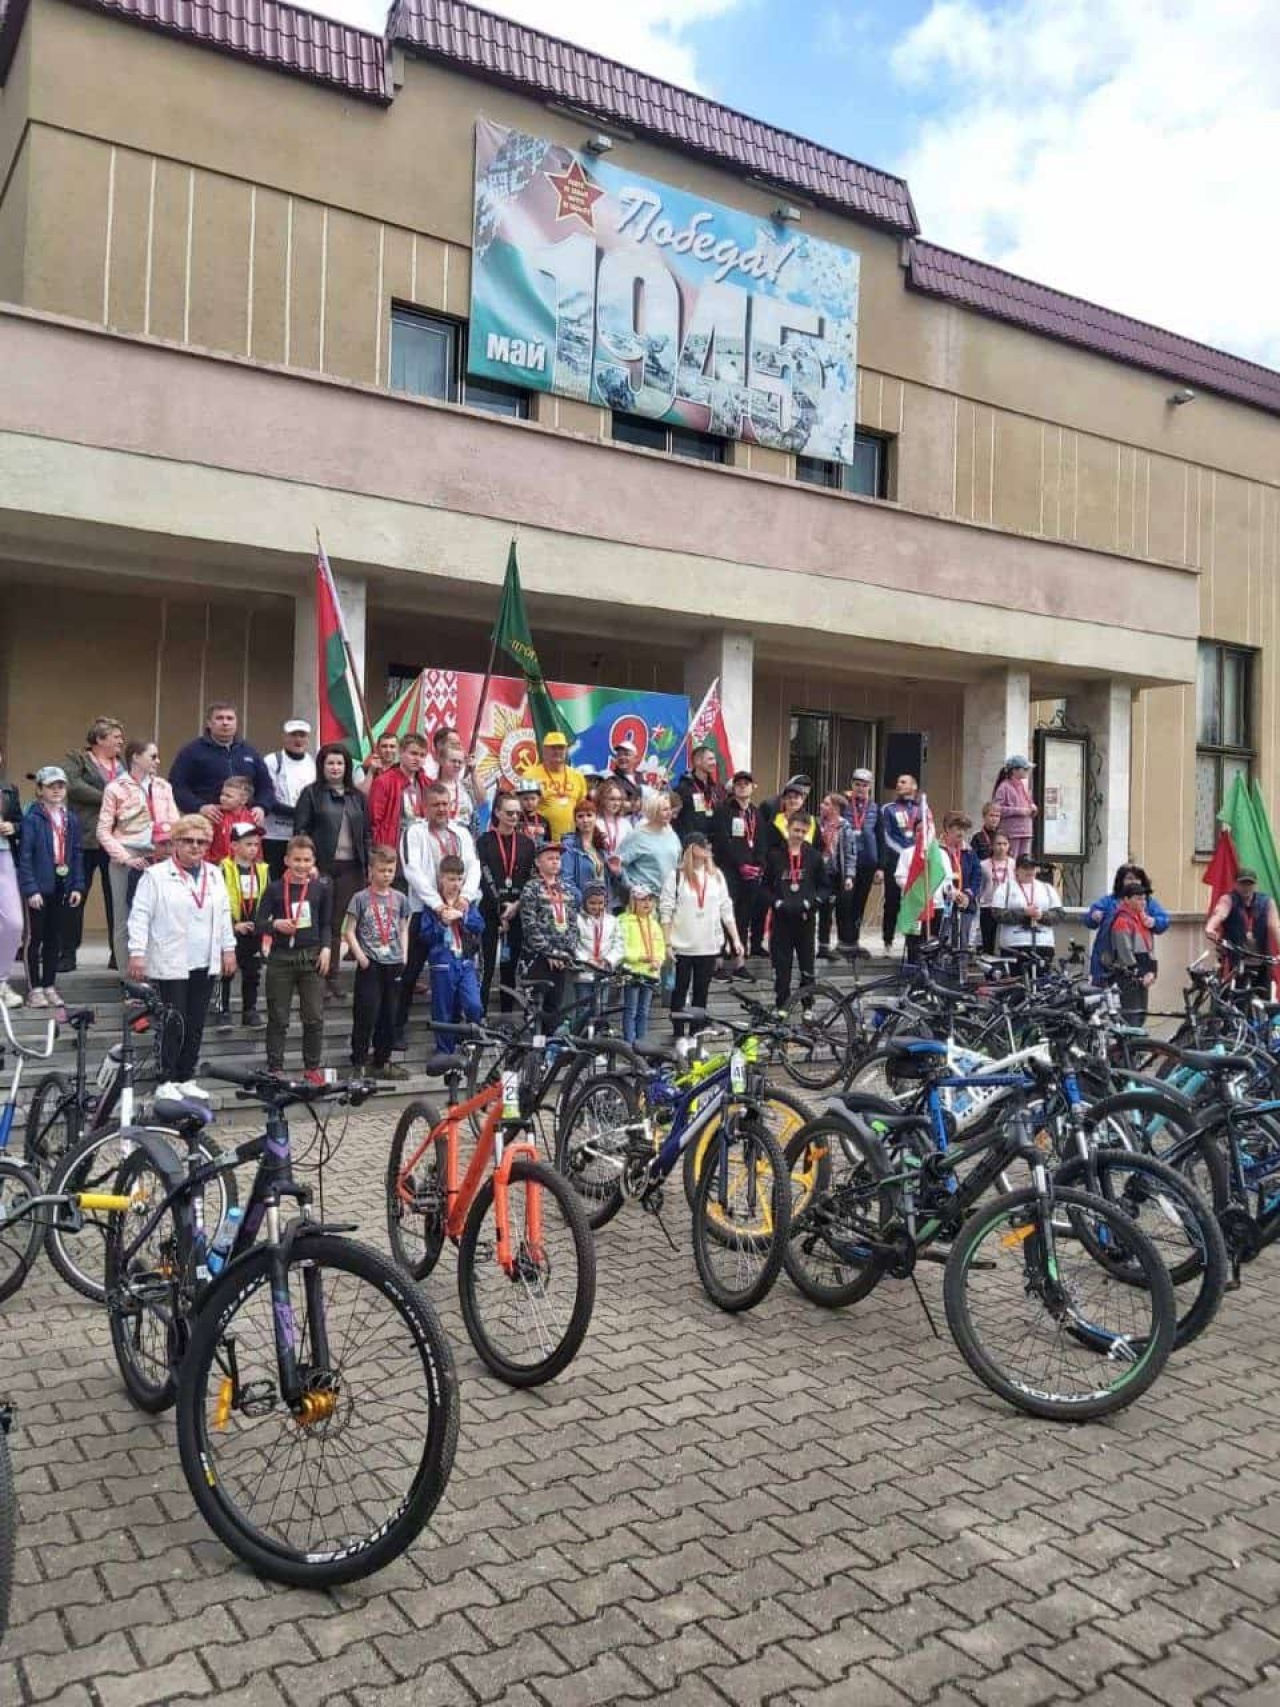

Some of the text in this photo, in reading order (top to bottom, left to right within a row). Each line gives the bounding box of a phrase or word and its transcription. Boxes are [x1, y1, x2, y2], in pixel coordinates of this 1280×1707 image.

[617, 187, 795, 283] Победа!
[487, 332, 545, 371] май
[533, 233, 823, 449] 1945
